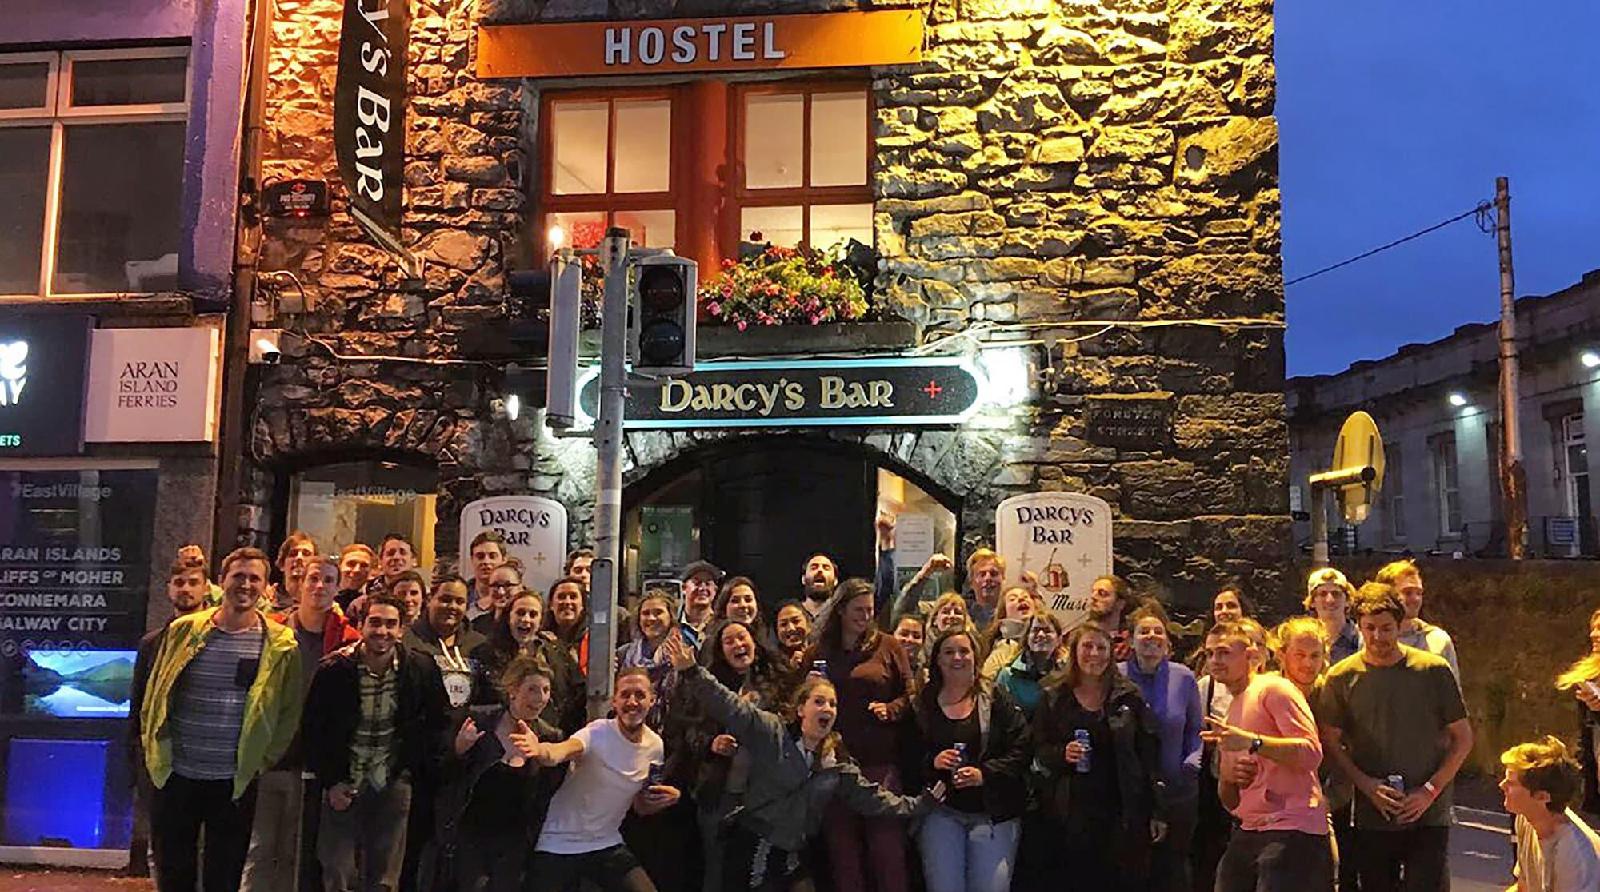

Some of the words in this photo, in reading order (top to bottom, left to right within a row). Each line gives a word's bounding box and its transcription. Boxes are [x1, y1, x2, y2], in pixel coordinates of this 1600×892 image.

[604, 22, 785, 65] HOSTEL
[120, 361, 179, 379] ARAN
[119, 380, 178, 393] ISLAND
[118, 395, 178, 408] FERRIES
[0, 547, 39, 561] RAN
[46, 547, 122, 561] ISLANDS
[42, 569, 58, 579] OF
[60, 570, 124, 584] MOHER
[1051, 593, 1089, 611] Musi
[67, 617, 107, 632] CITY
